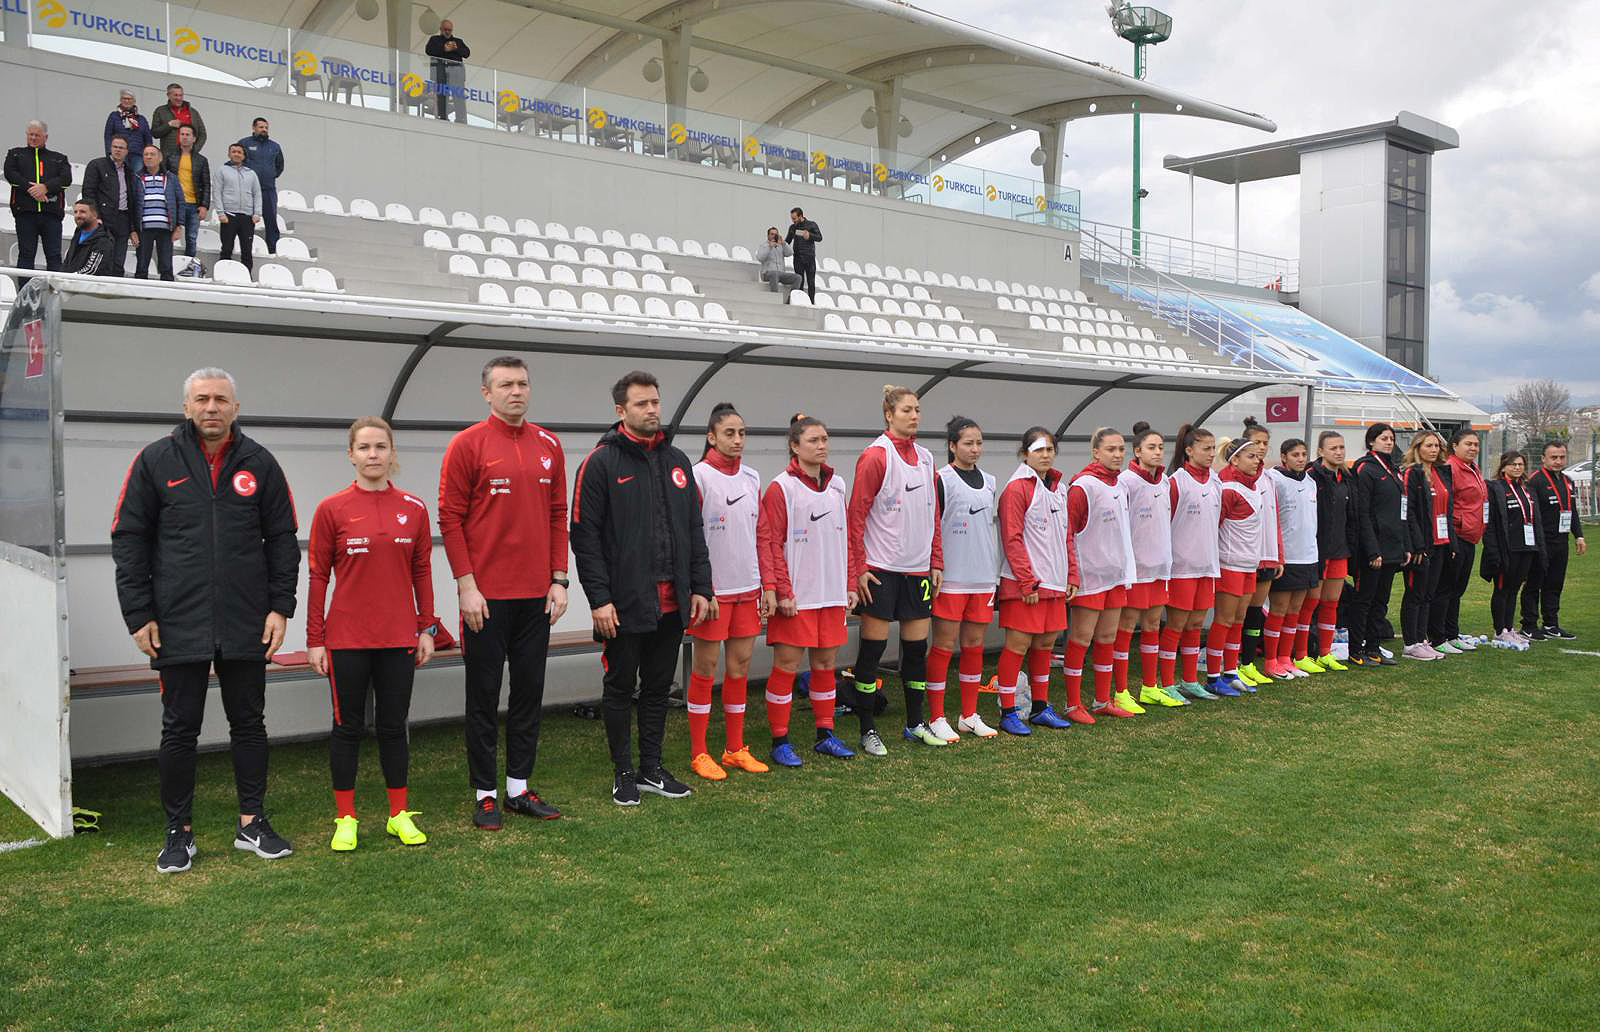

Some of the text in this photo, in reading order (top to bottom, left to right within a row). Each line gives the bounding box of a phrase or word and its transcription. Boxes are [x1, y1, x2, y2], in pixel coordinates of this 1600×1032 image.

[0, 0, 28, 14] LL
[69, 10, 167, 43] TURKCELL
[202, 37, 287, 66] TURKCELL
[320, 60, 396, 86] TURKCELL
[424, 79, 495, 104] TURKCELL
[520, 97, 583, 121] TURKCELL
[607, 114, 666, 136] TURKCELL
[686, 129, 740, 149] TURKCELL
[760, 144, 809, 163] TURKCELL
[827, 156, 871, 175] TURKCELL
[888, 168, 929, 185] TURKCELL
[945, 180, 983, 196] TURKCELL
[998, 190, 1034, 206] TURKCELL
[1047, 200, 1080, 214] TURKCELL
[1064, 244, 1072, 261] A
